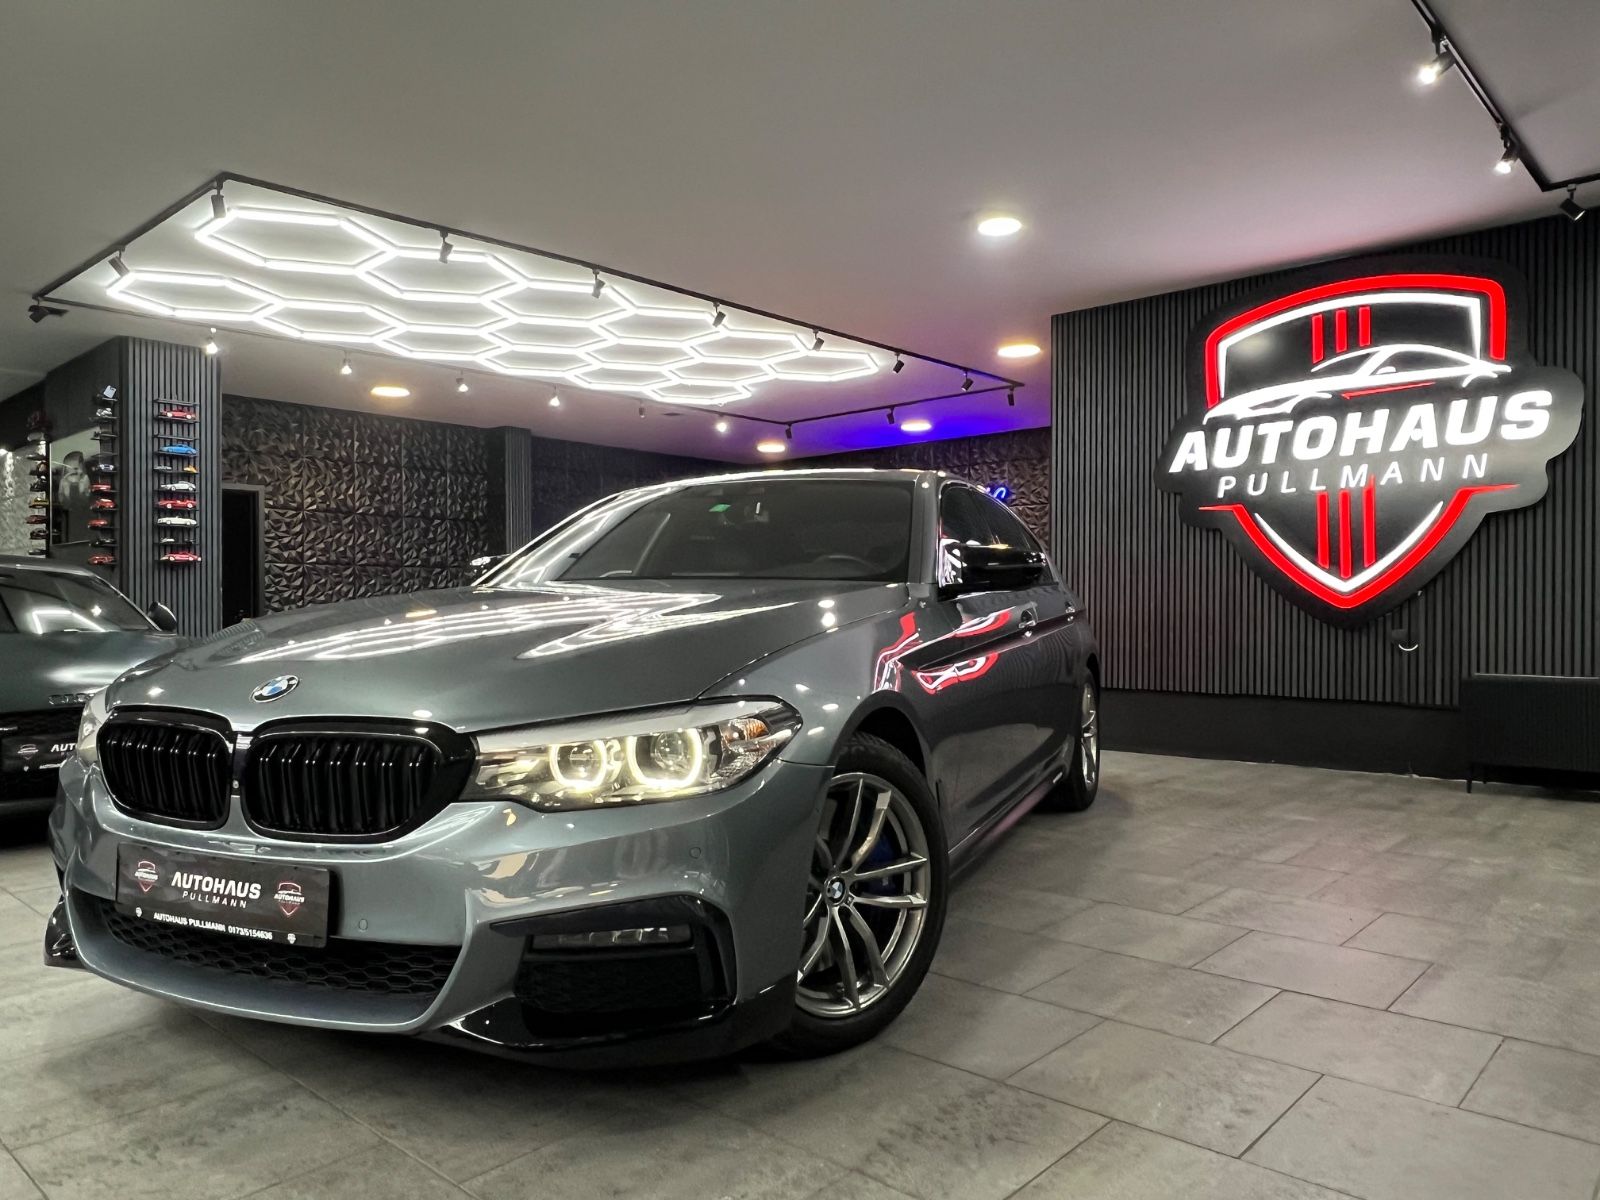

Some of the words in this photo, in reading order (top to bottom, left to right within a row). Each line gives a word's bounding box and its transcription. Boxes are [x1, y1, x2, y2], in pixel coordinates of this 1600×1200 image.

[1168, 389, 1553, 474] AUTOHAUS
[1216, 452, 1488, 499] PULLMANN
[171, 871, 262, 900] AUTOHAUS
[182, 890, 247, 909] PULLMANN
[153, 912, 187, 925] AUTOHAUS
[189, 918, 225, 932] PULLMANN
